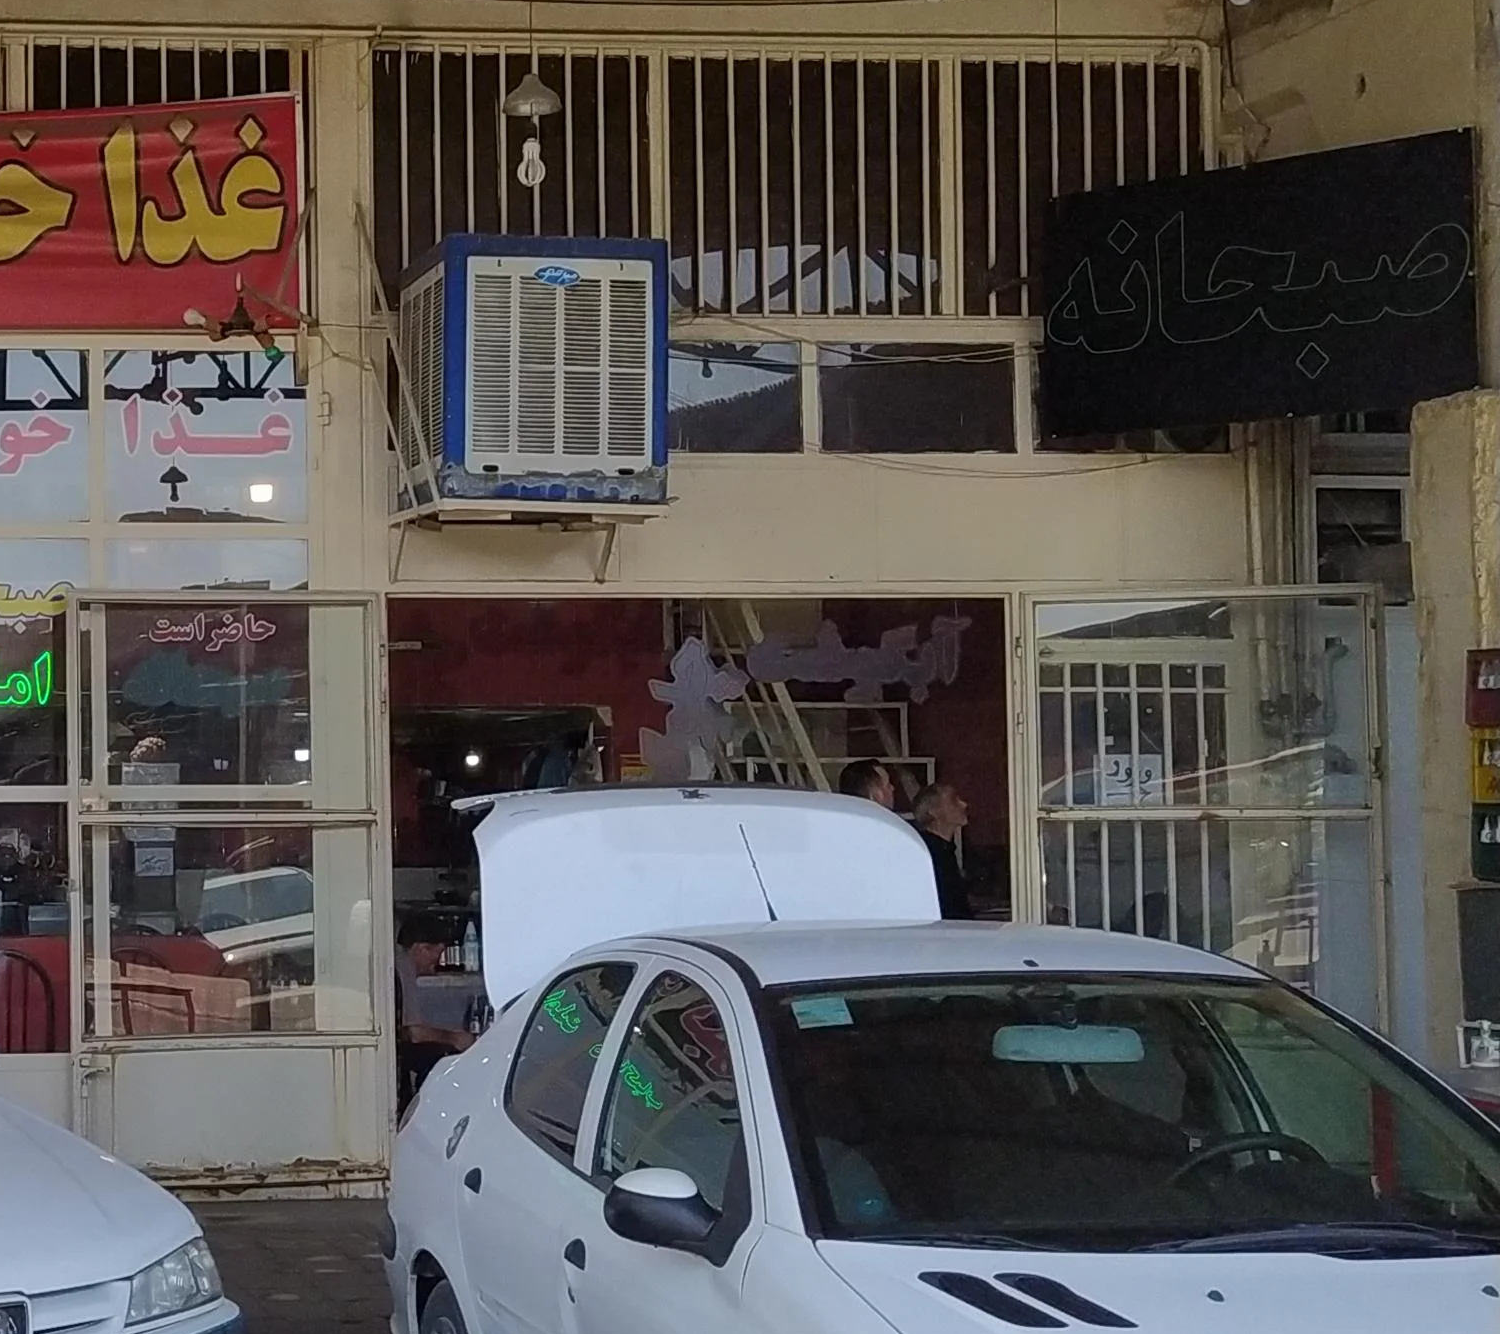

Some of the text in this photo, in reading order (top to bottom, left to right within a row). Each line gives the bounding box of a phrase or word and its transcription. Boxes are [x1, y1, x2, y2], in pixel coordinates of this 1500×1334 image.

[101, 114, 289, 266] غذا
[1047, 211, 1470, 379] صبحانه
[121, 385, 293, 457] غذا
